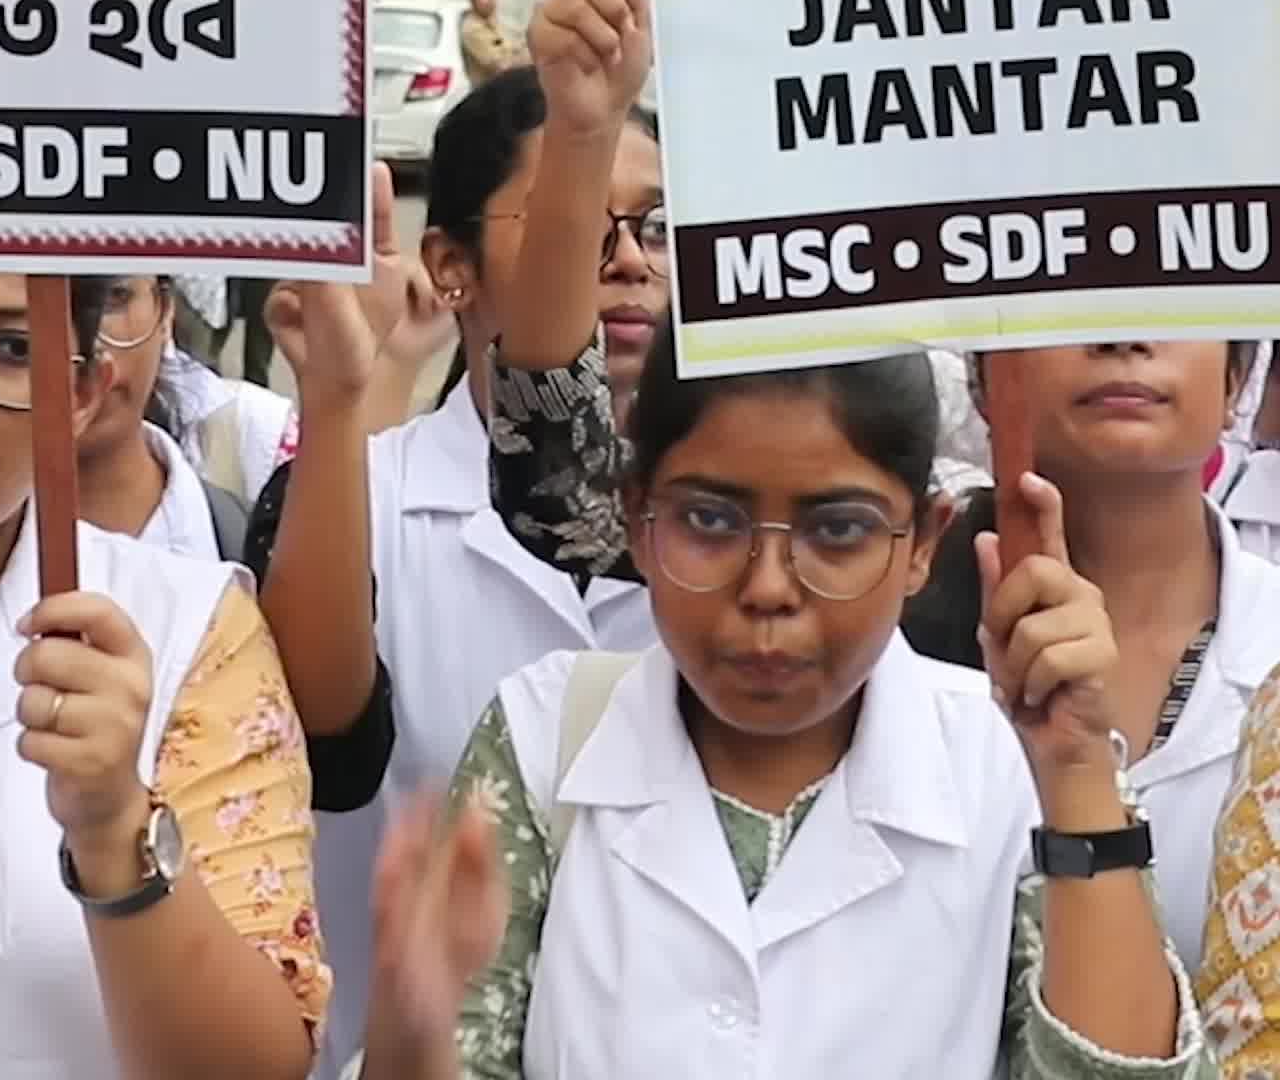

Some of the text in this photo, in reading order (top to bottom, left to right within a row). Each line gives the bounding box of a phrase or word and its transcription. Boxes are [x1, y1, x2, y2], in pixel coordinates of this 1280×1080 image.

[776, 51, 1199, 150] MANTAR
[208, 129, 324, 203] NU
[715, 202, 1268, 305] MSC SDF NU
